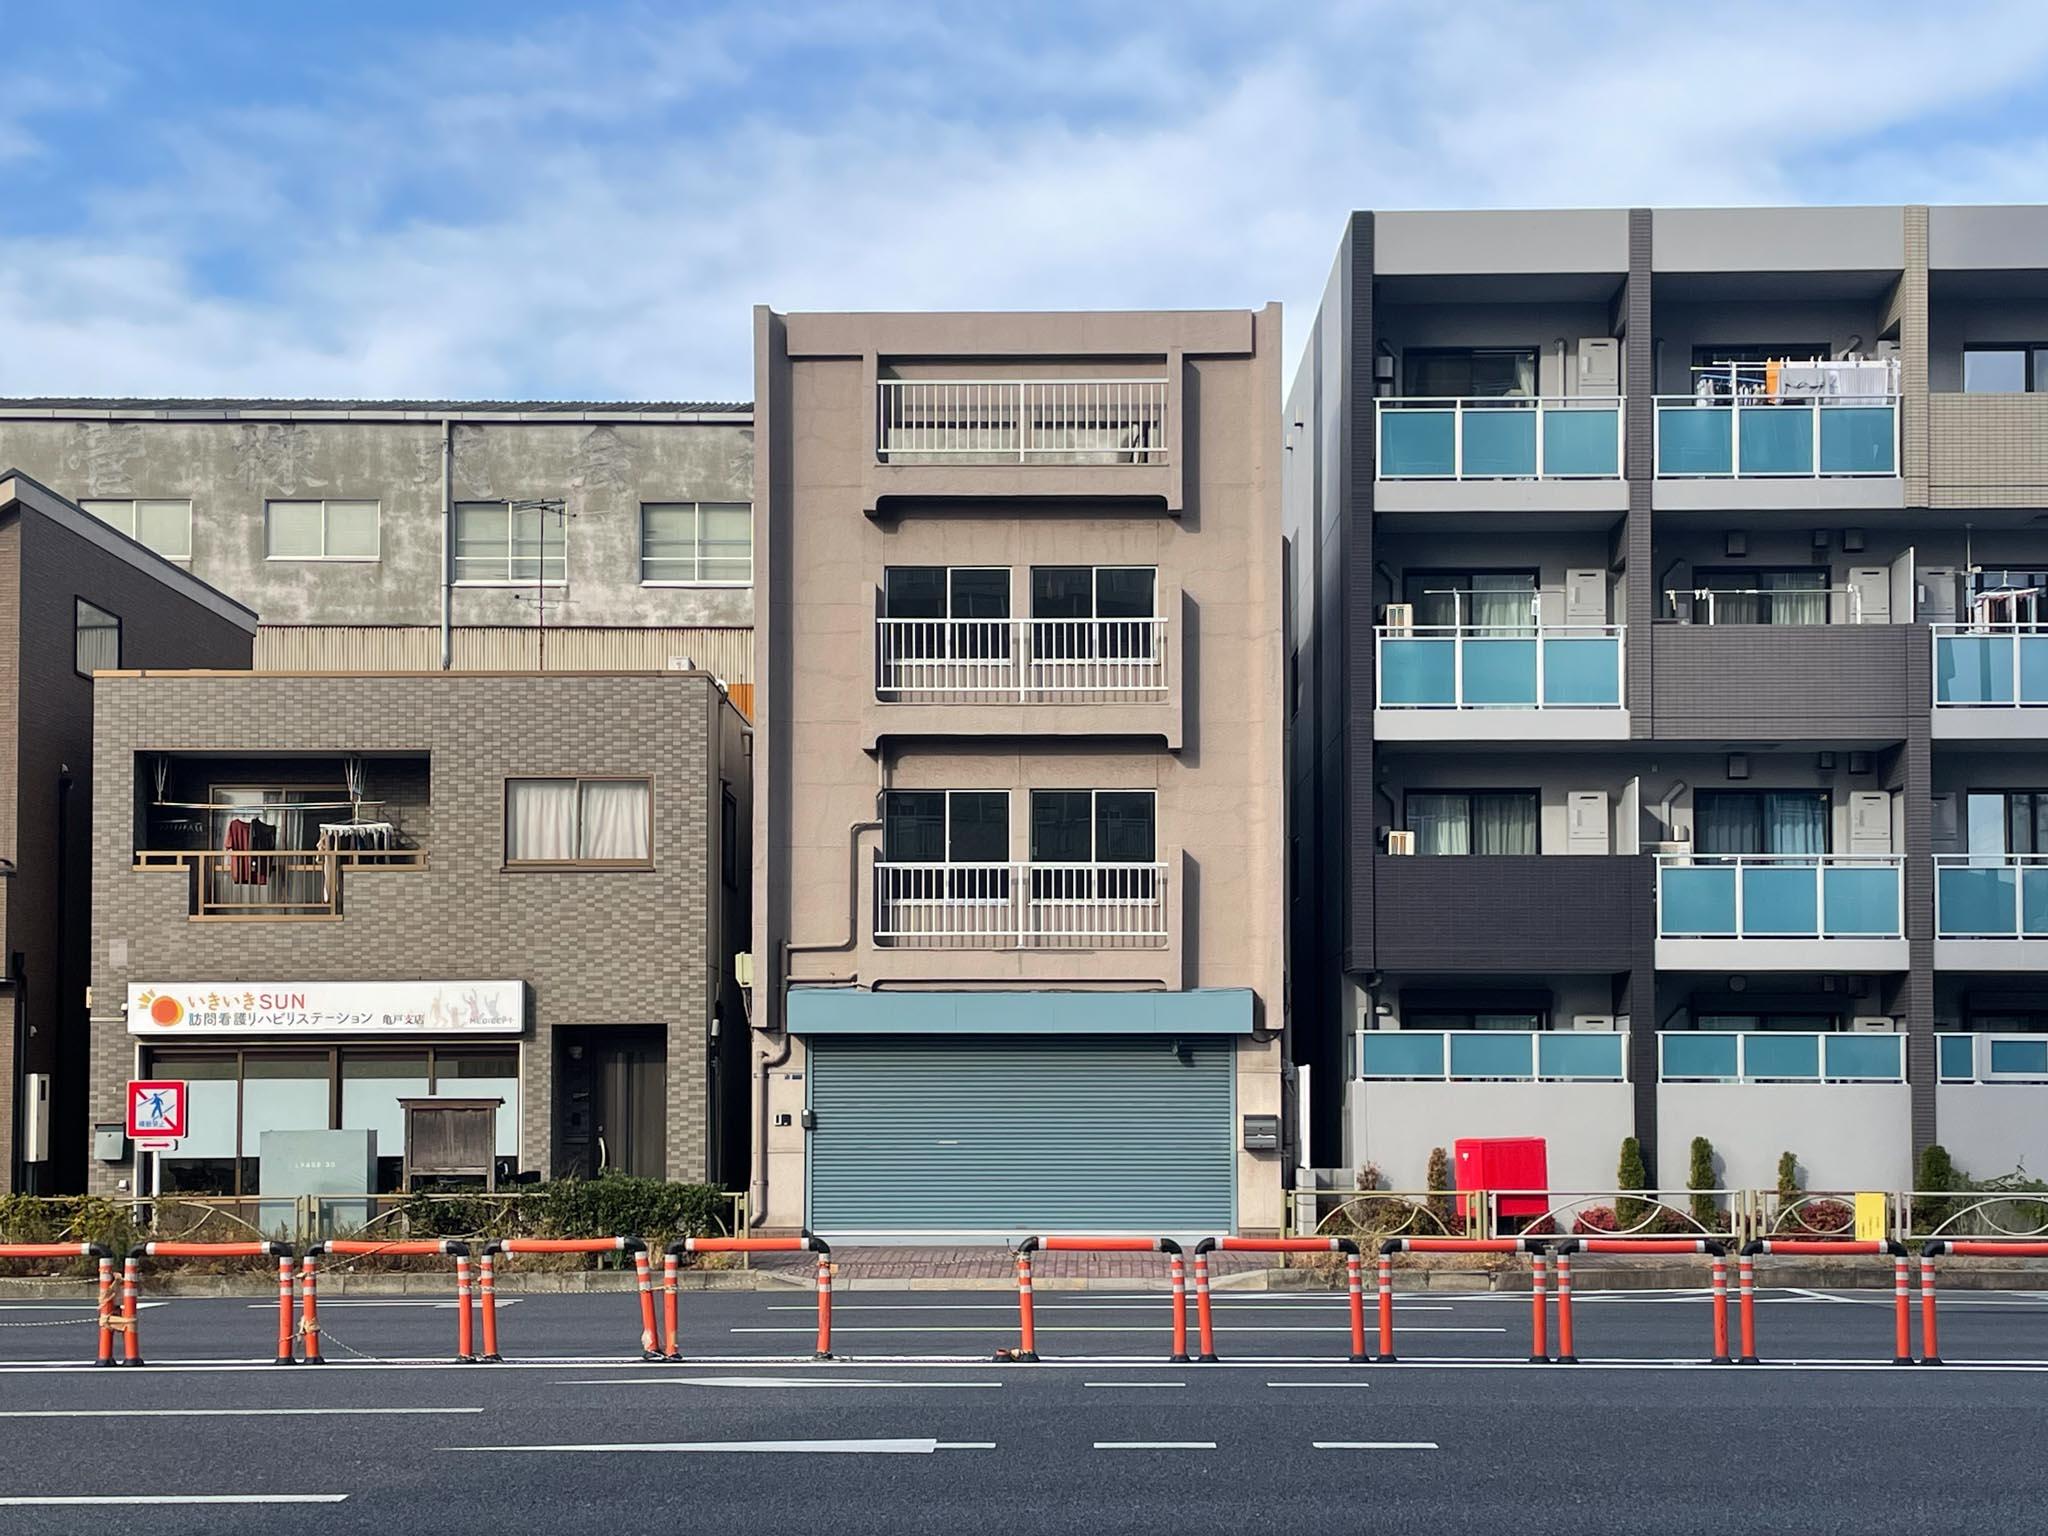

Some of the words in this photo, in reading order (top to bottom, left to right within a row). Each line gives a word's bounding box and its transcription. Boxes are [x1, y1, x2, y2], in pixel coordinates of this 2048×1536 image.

[188, 992, 305, 1010] いきいきSUN
[188, 1012, 373, 1026] 訪問看護リハビリステーション
[382, 1013, 425, 1025] 亀戸支店
